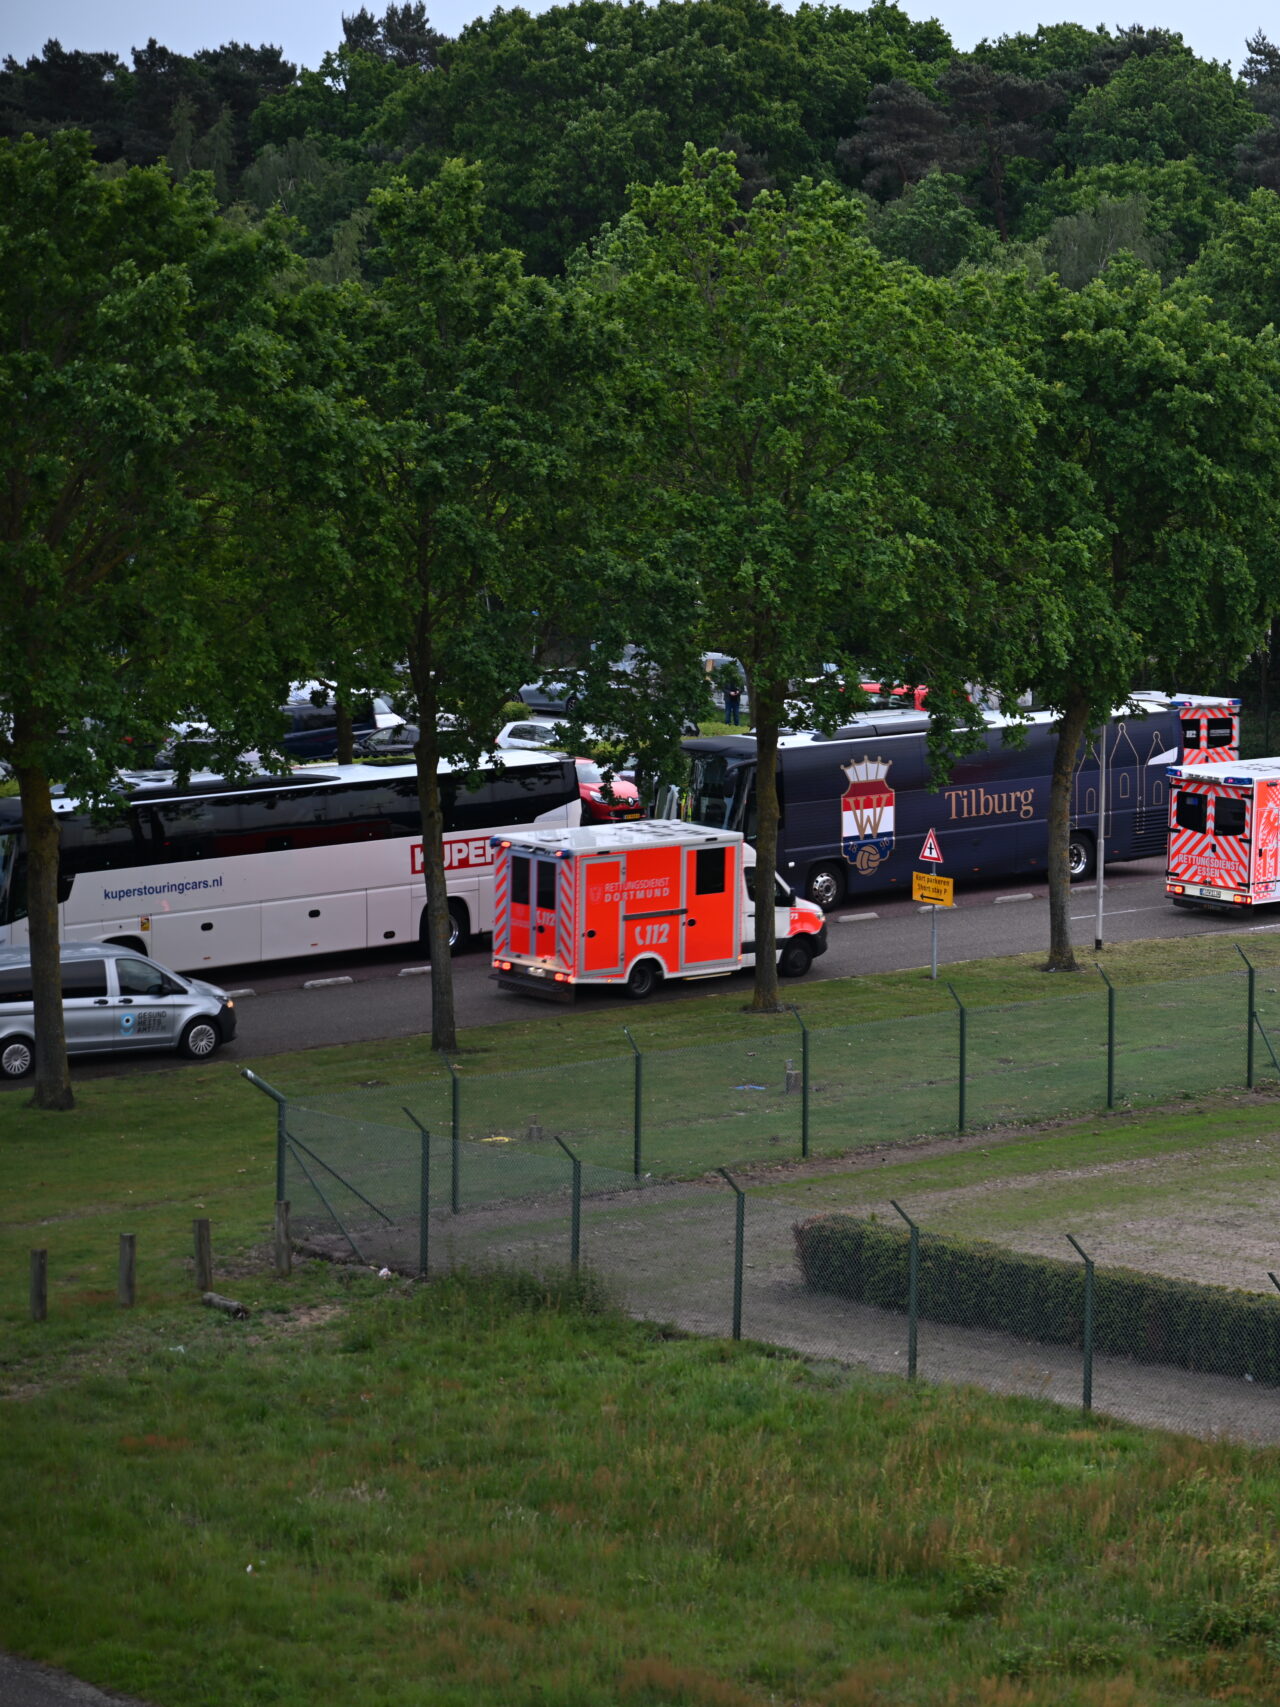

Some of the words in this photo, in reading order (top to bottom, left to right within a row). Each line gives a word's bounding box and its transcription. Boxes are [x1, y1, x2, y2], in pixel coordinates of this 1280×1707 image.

[945, 788, 1034, 819] Tilburg
[1178, 853, 1240, 871] RETTUNGSDIENST
[1198, 866, 1219, 877] ESSEN
[604, 877, 670, 892] RETTUNGSDIENST
[915, 874, 925, 882] Kort
[927, 877, 950, 886] parkeren
[104, 876, 222, 901] kuperstouringcars.nl
[604, 887, 670, 903] DORTMUND
[918, 883, 930, 892] Short
[932, 887, 942, 895] stay
[645, 923, 670, 945] 112
[138, 1010, 166, 1020] GESUND
